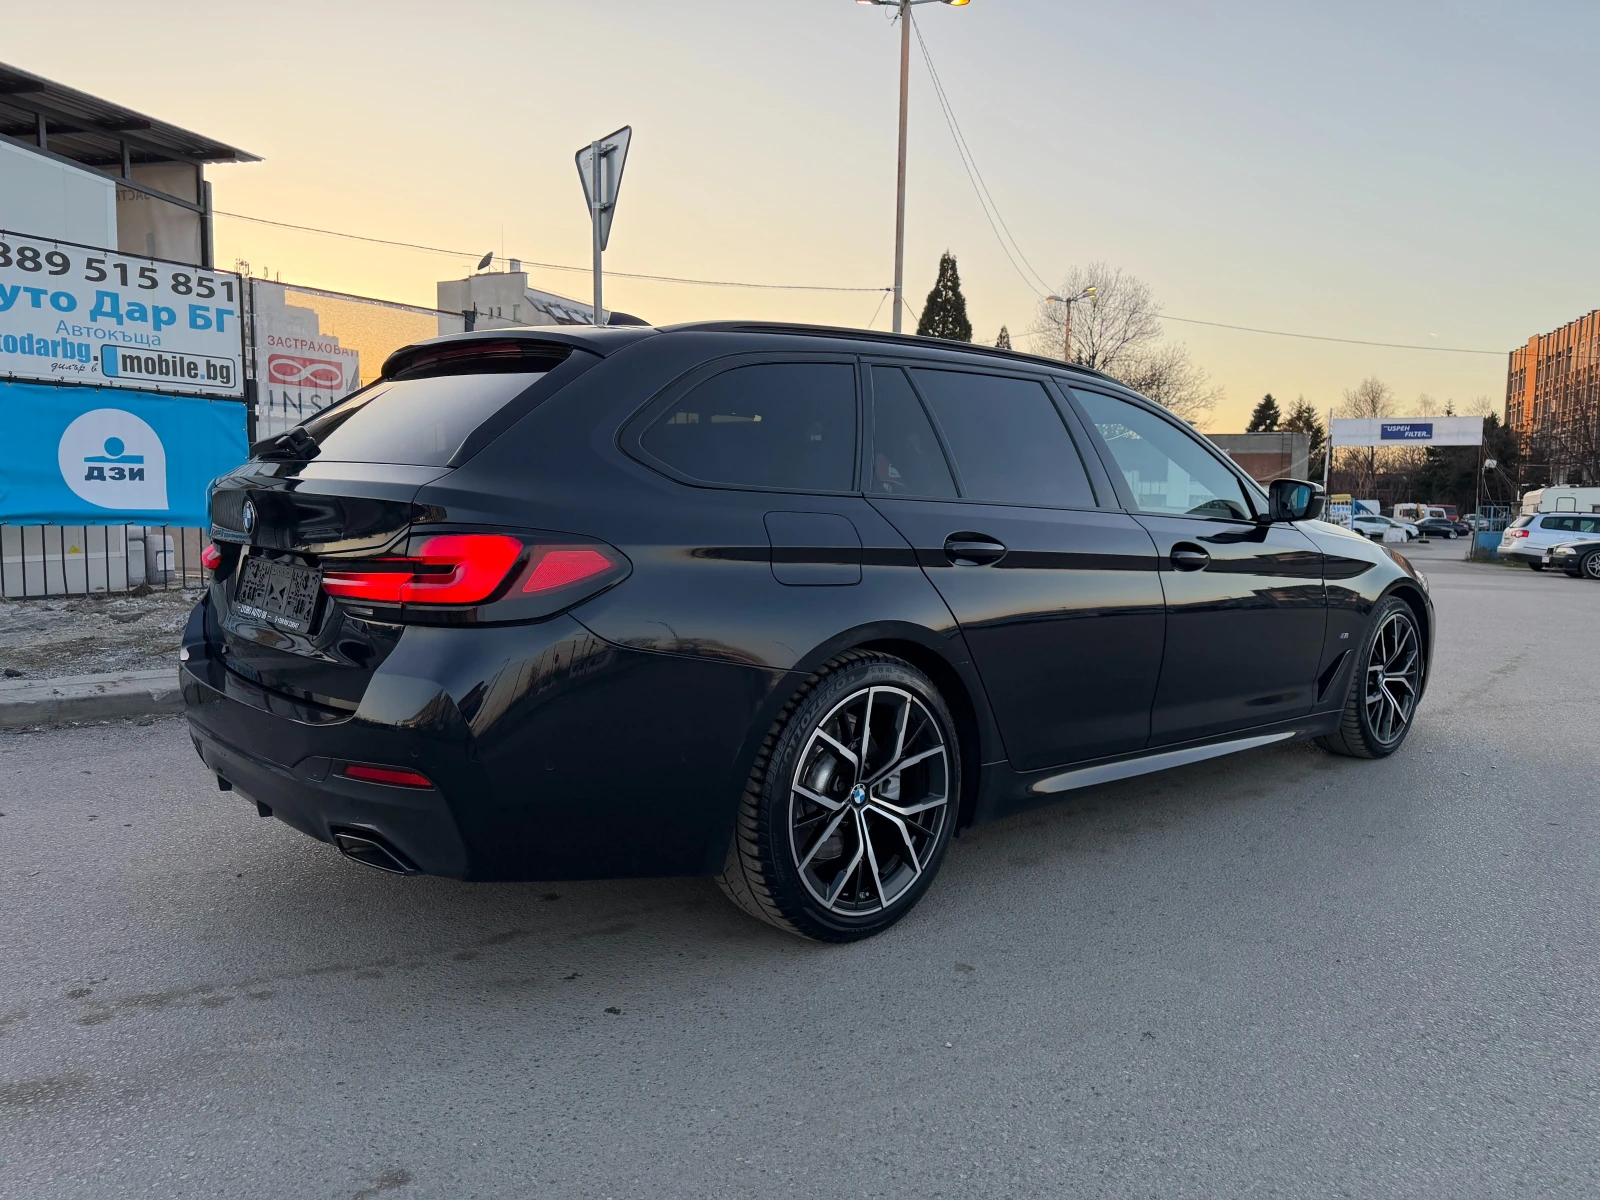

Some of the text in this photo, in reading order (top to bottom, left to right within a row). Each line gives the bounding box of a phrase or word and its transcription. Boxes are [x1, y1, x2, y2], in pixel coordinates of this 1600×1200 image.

[84, 257, 159, 290] 515
[171, 272, 234, 302] 851
[89, 290, 177, 332] Дар
[188, 304, 235, 333] БГ
[55, 320, 161, 347] Автокъща
[121, 354, 231, 384] mobile.bg
[269, 390, 334, 415] INS
[84, 466, 145, 481] ДЗИ
